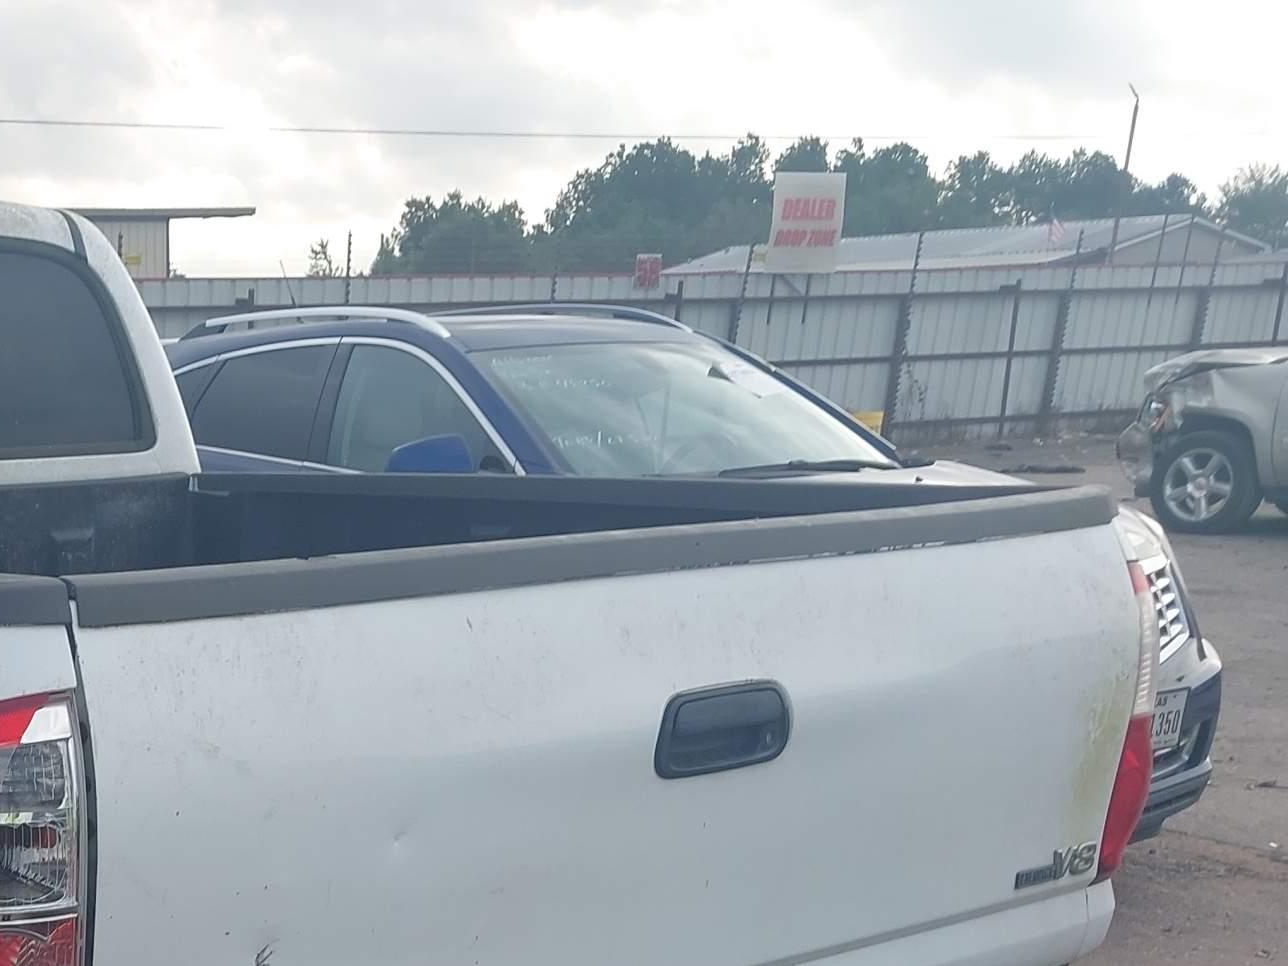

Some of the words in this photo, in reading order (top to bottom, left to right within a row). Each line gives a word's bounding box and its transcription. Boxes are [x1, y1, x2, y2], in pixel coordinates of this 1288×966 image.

[781, 198, 836, 221] DEALER
[774, 229, 808, 249] DROP
[807, 229, 837, 249] ZONE
